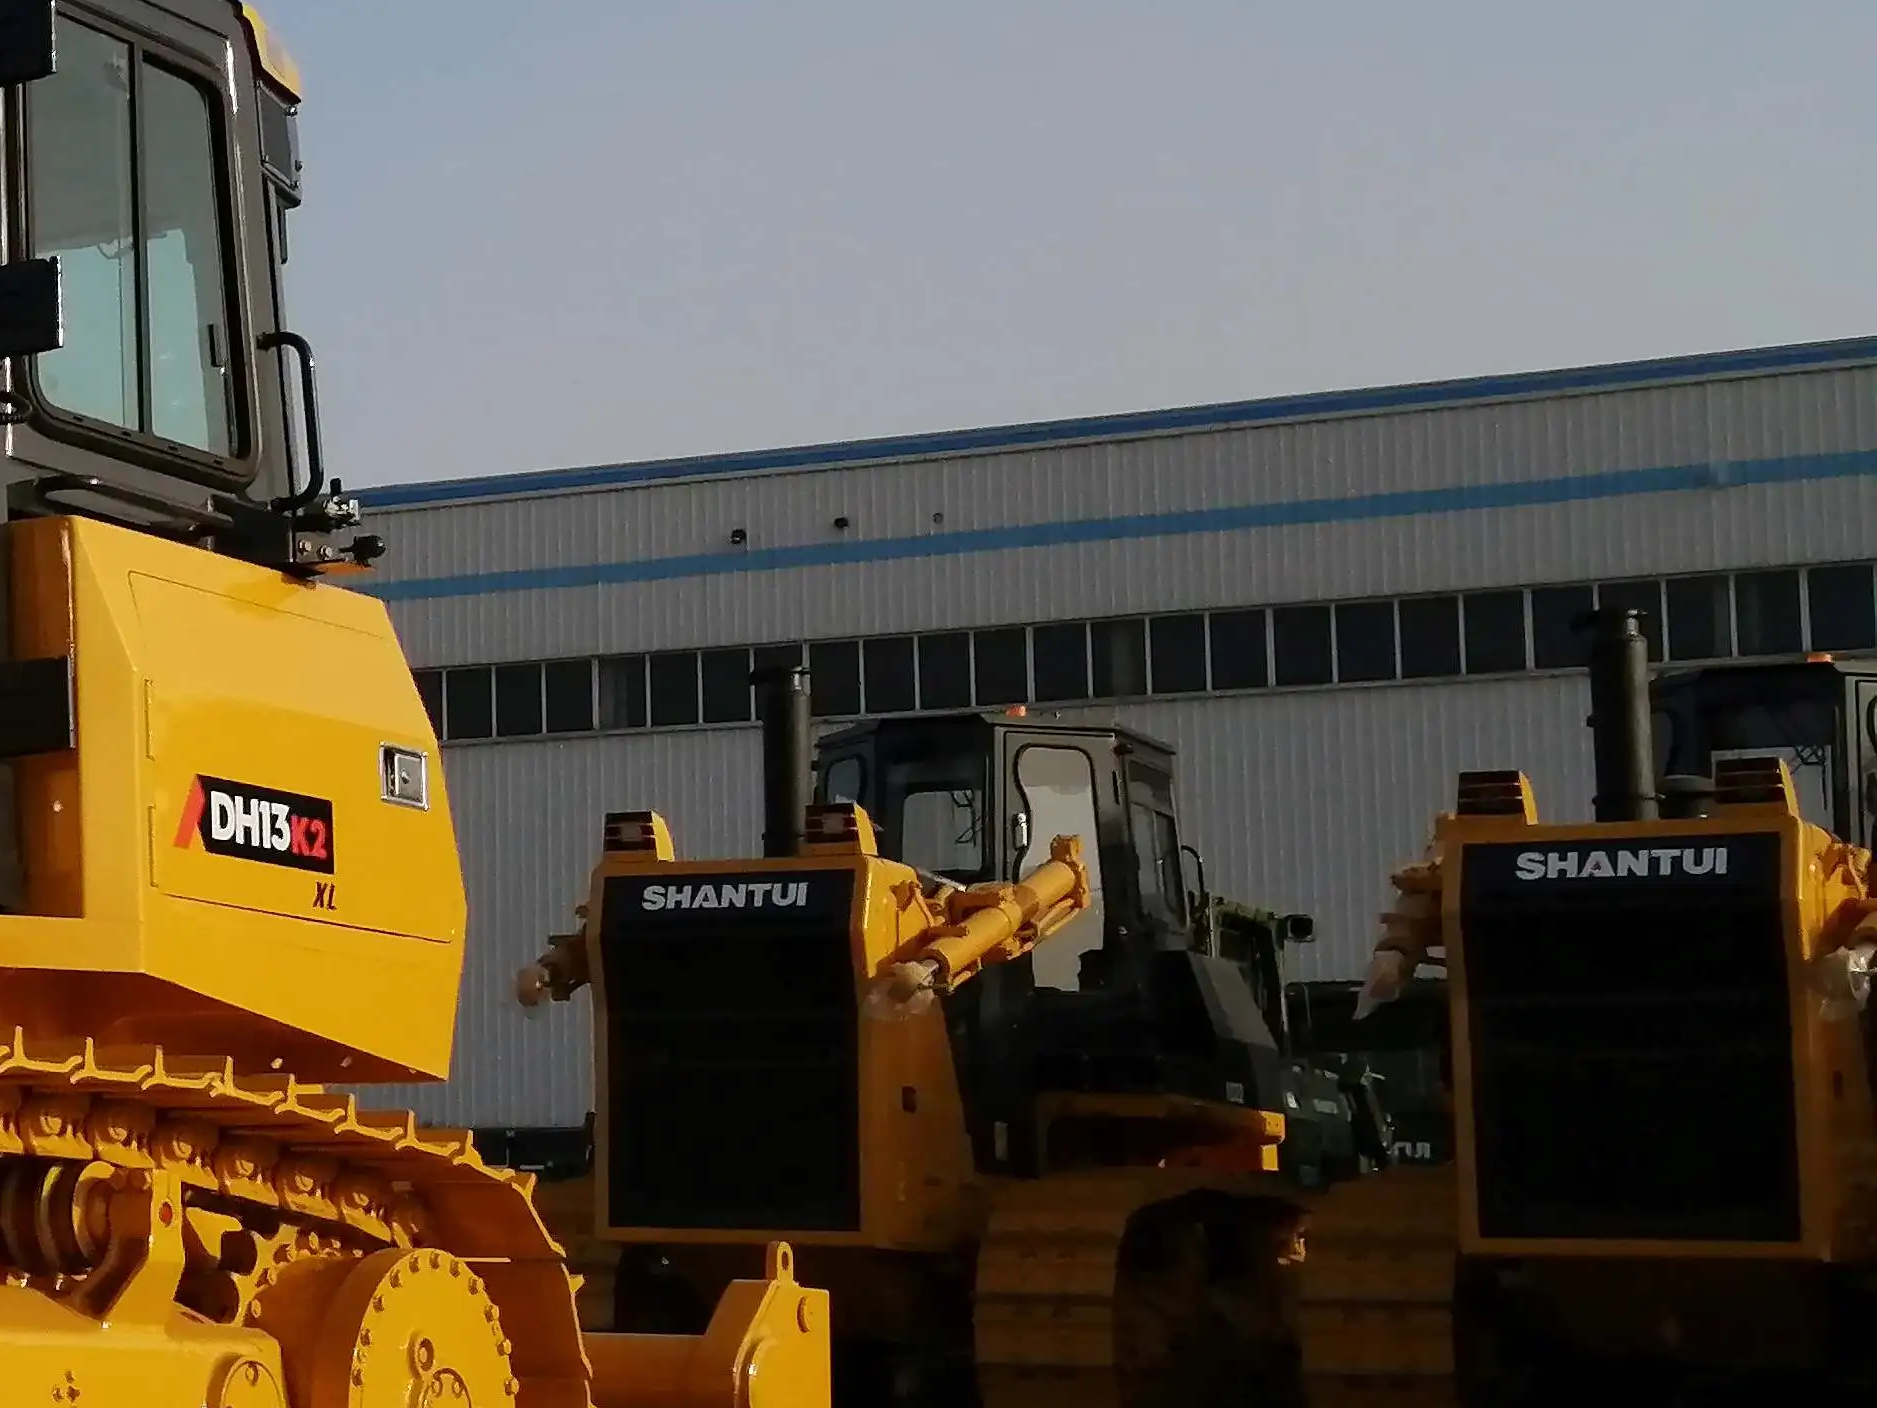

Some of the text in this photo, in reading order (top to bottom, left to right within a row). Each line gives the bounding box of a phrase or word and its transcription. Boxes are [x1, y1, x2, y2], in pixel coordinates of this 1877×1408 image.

[210, 790, 328, 860] DH13K2
[1515, 847, 1728, 880] SHANTUI
[312, 881, 337, 910] XL
[641, 882, 808, 911] SHANTUI
